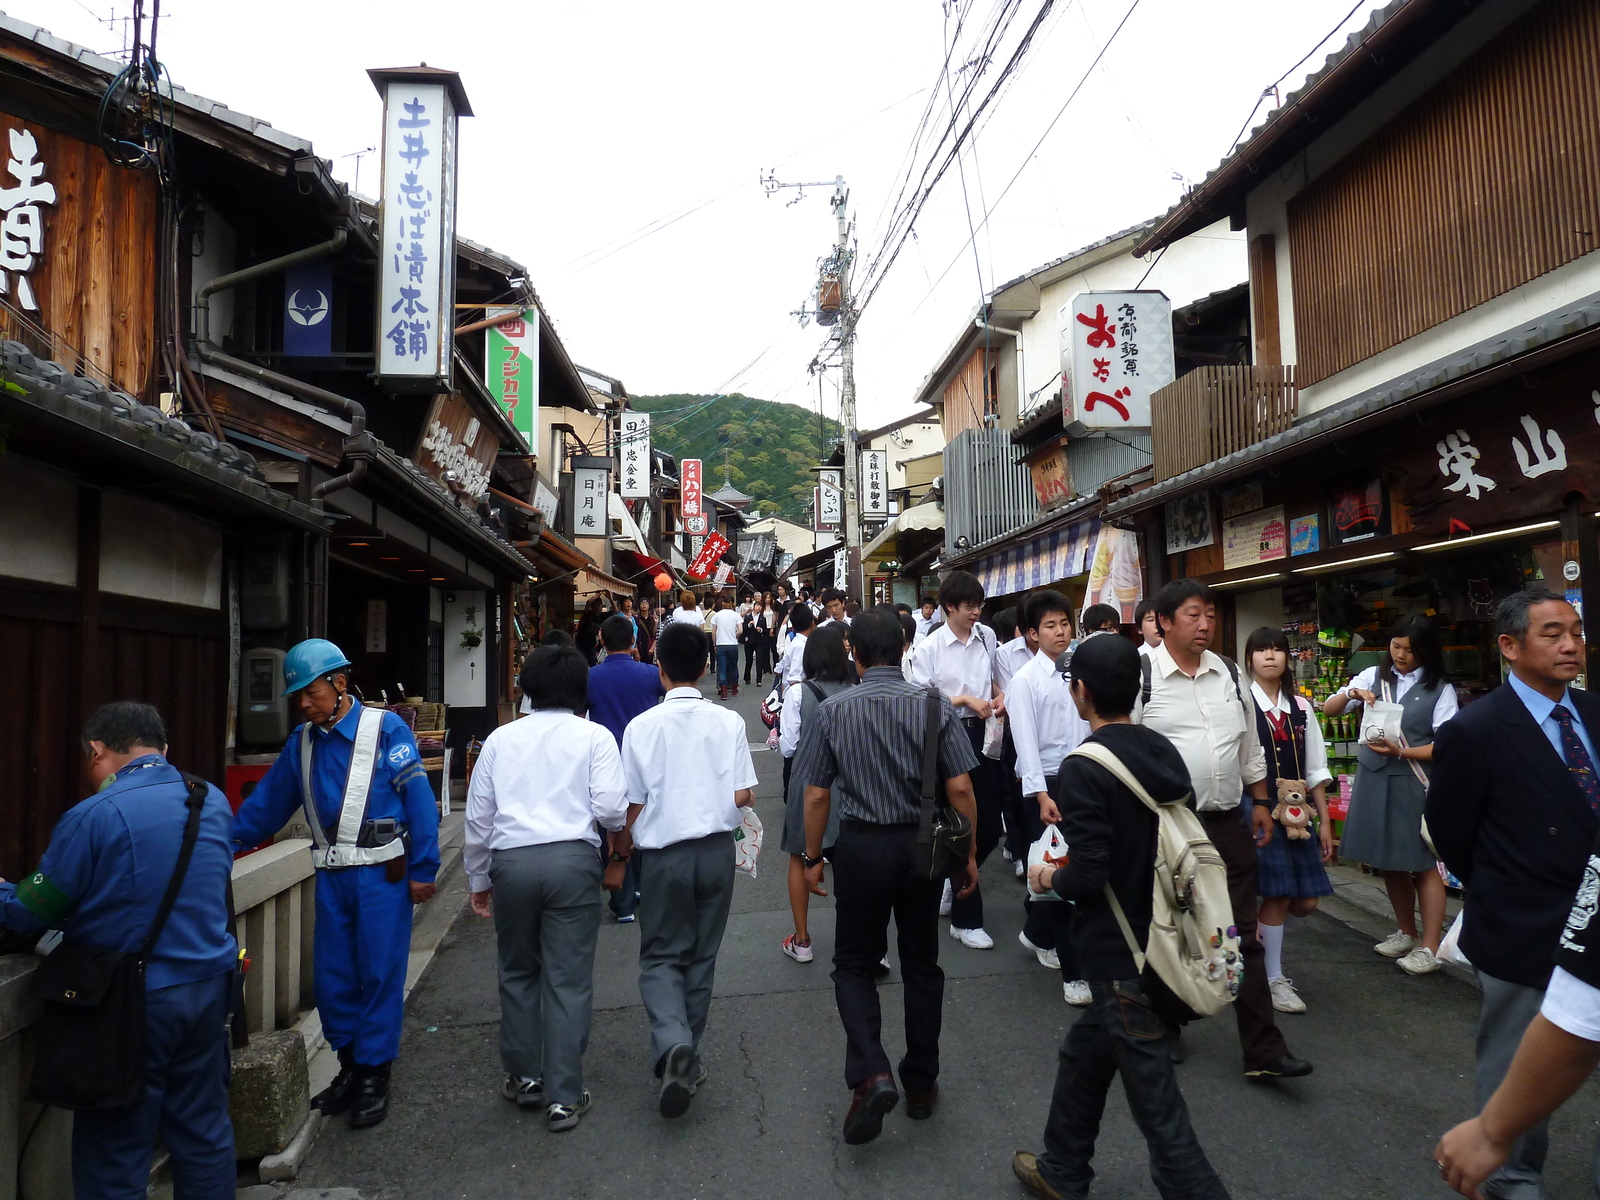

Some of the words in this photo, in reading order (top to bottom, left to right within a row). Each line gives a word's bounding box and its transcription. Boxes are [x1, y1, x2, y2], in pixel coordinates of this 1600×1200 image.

[386, 97, 432, 362] 土井志ば漬本舗
[1076, 303, 1132, 422] おたべ
[1117, 303, 1140, 377] 京都銘菓
[502, 345, 520, 424] フジカラー
[1435, 389, 1600, 501] 栄山
[580, 479, 596, 528] 日月庵
[597, 473, 605, 498] 京料理
